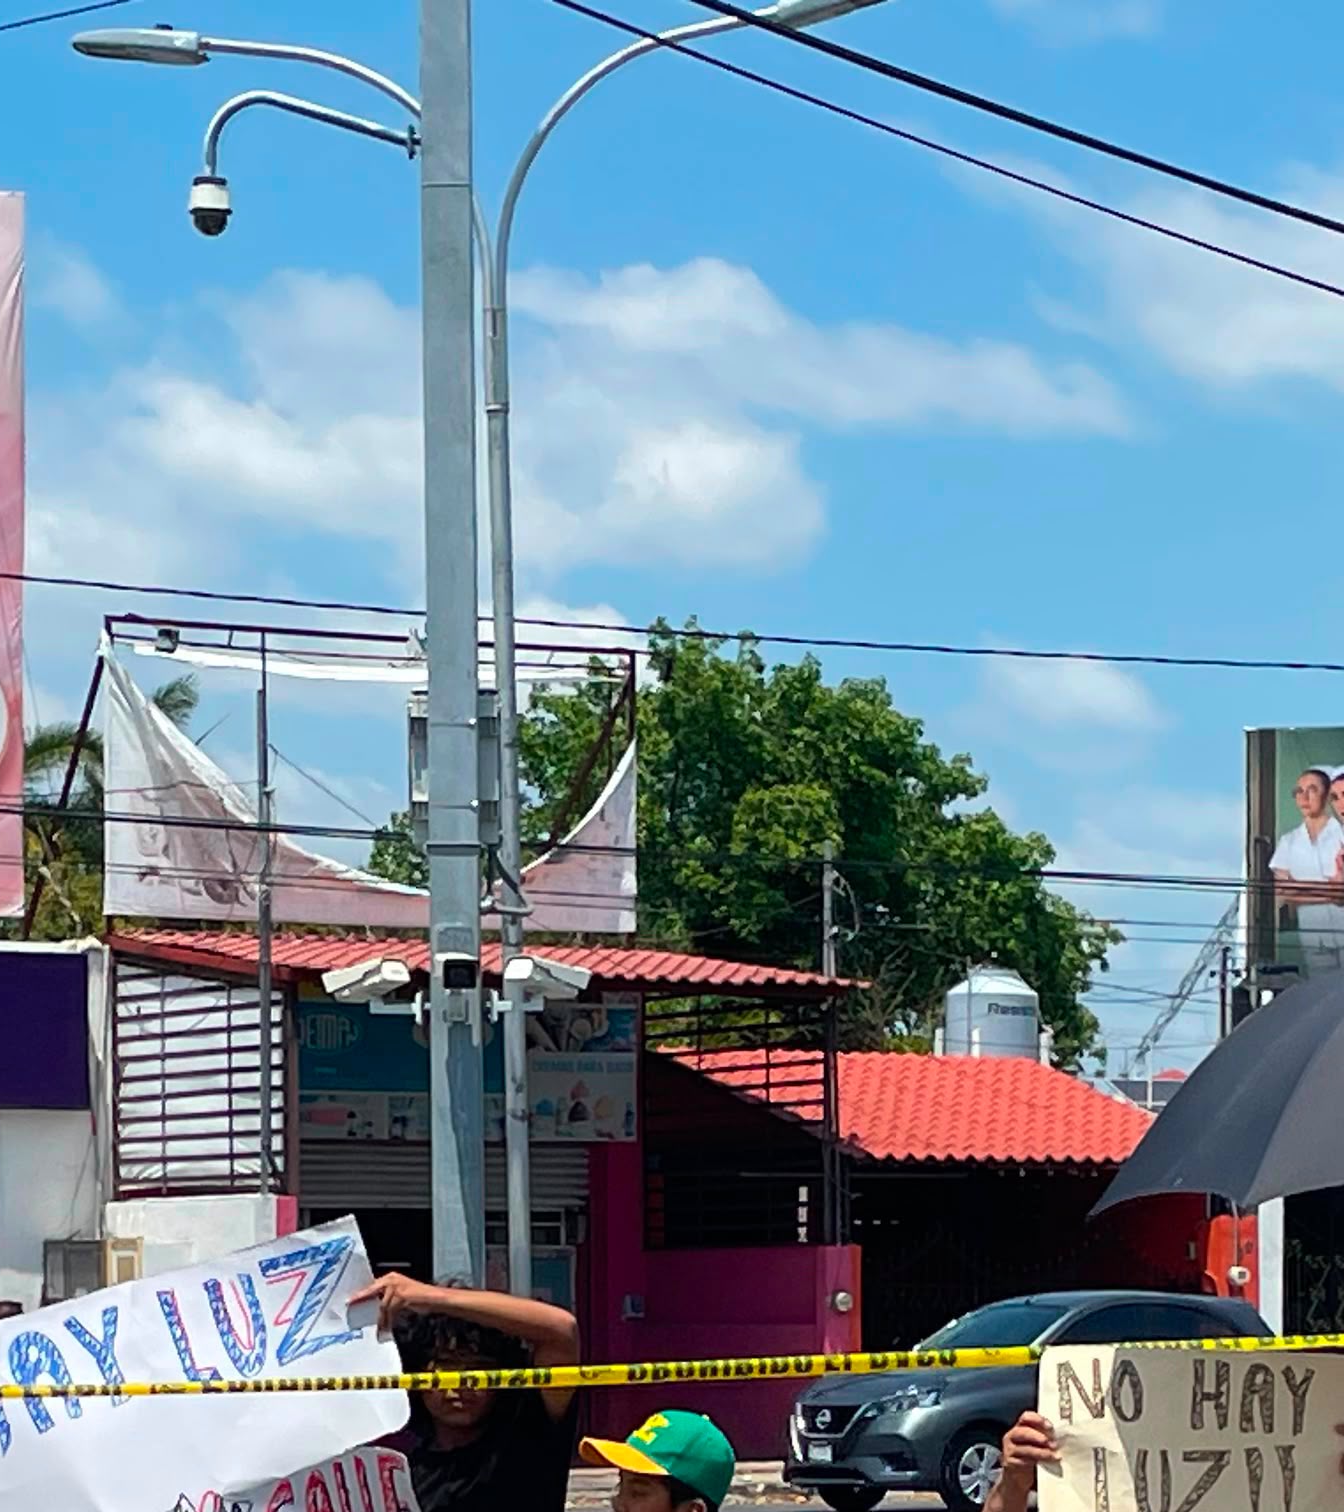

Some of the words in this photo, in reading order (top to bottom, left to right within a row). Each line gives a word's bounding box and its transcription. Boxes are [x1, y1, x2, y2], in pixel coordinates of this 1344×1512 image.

[157, 1233, 363, 1384] LUZ
[1057, 1357, 1144, 1425] NO
[1189, 1358, 1315, 1436] HAY
